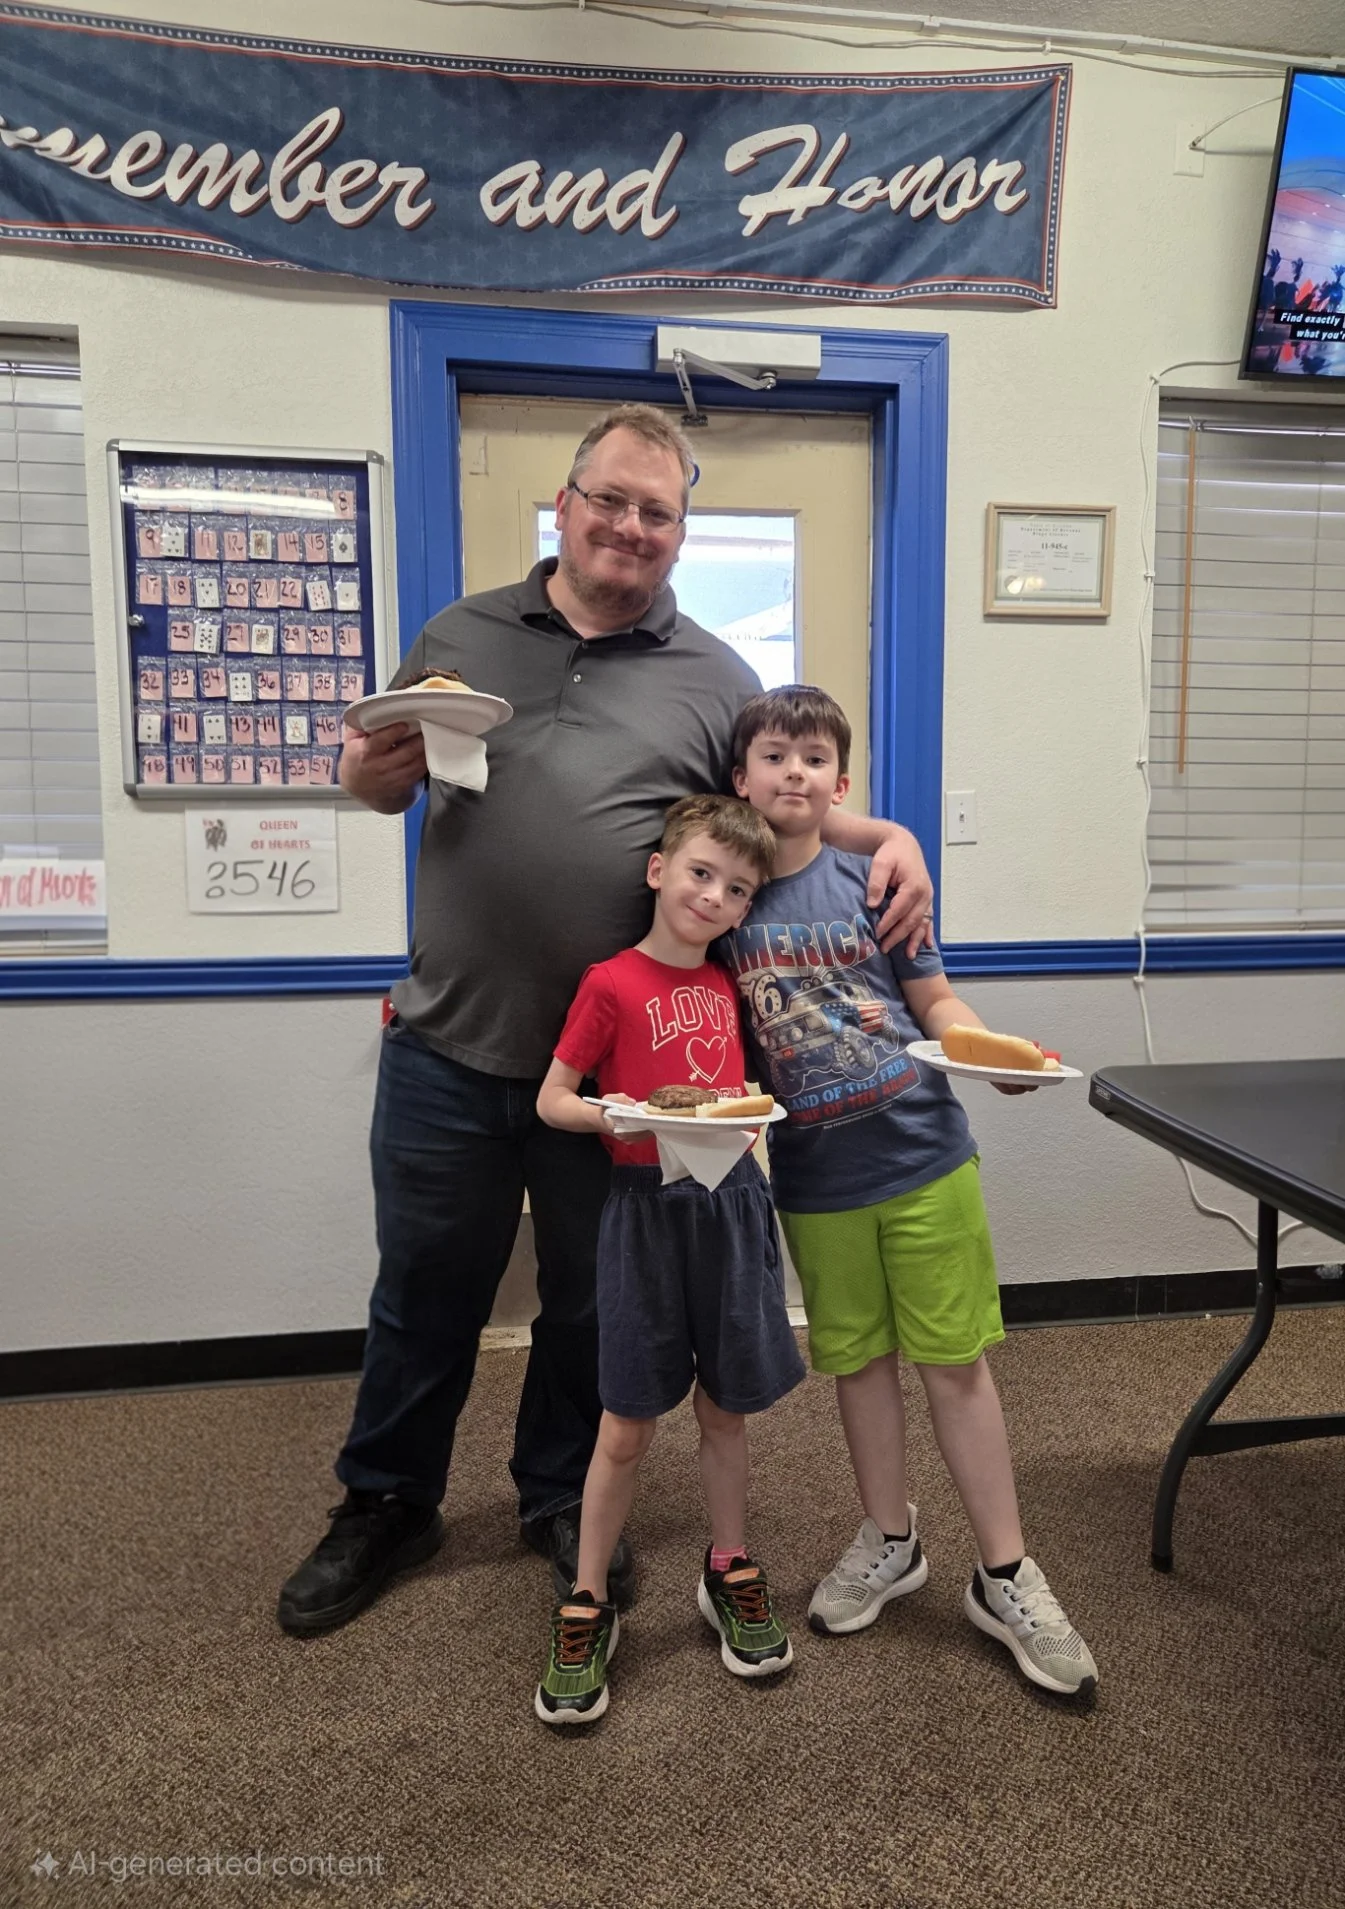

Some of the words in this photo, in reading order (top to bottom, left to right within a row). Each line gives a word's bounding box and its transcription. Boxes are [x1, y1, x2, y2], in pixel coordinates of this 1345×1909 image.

[480, 131, 687, 239] and
[724, 123, 1030, 237] Honor
[1280, 312, 1304, 323] Find
[1304, 315, 1341, 327] exactly
[1296, 329, 1320, 339] what
[145, 529, 156, 549] 9
[283, 533, 298, 552] 14
[307, 534, 325, 550] 15
[173, 580, 187, 595] 18
[226, 581, 247, 596] 20
[253, 581, 269, 599] 21
[281, 581, 298, 599] 22
[310, 629, 328, 643] 30
[140, 672, 159, 690] 32
[171, 668, 189, 686] 33
[202, 670, 220, 689] 34
[257, 672, 276, 689] 36
[315, 674, 332, 690] 38
[340, 675, 357, 689] 39
[316, 715, 336, 733] 46
[174, 756, 195, 773] 49
[203, 758, 225, 772] 50
[259, 759, 281, 774] 52
[287, 760, 306, 776] 53
[311, 756, 331, 775] 54
[259, 820, 298, 831] QUEEN
[268, 840, 311, 850] HEARTS
[822, 1086, 843, 1103] OF
[879, 1058, 909, 1083] FREE
